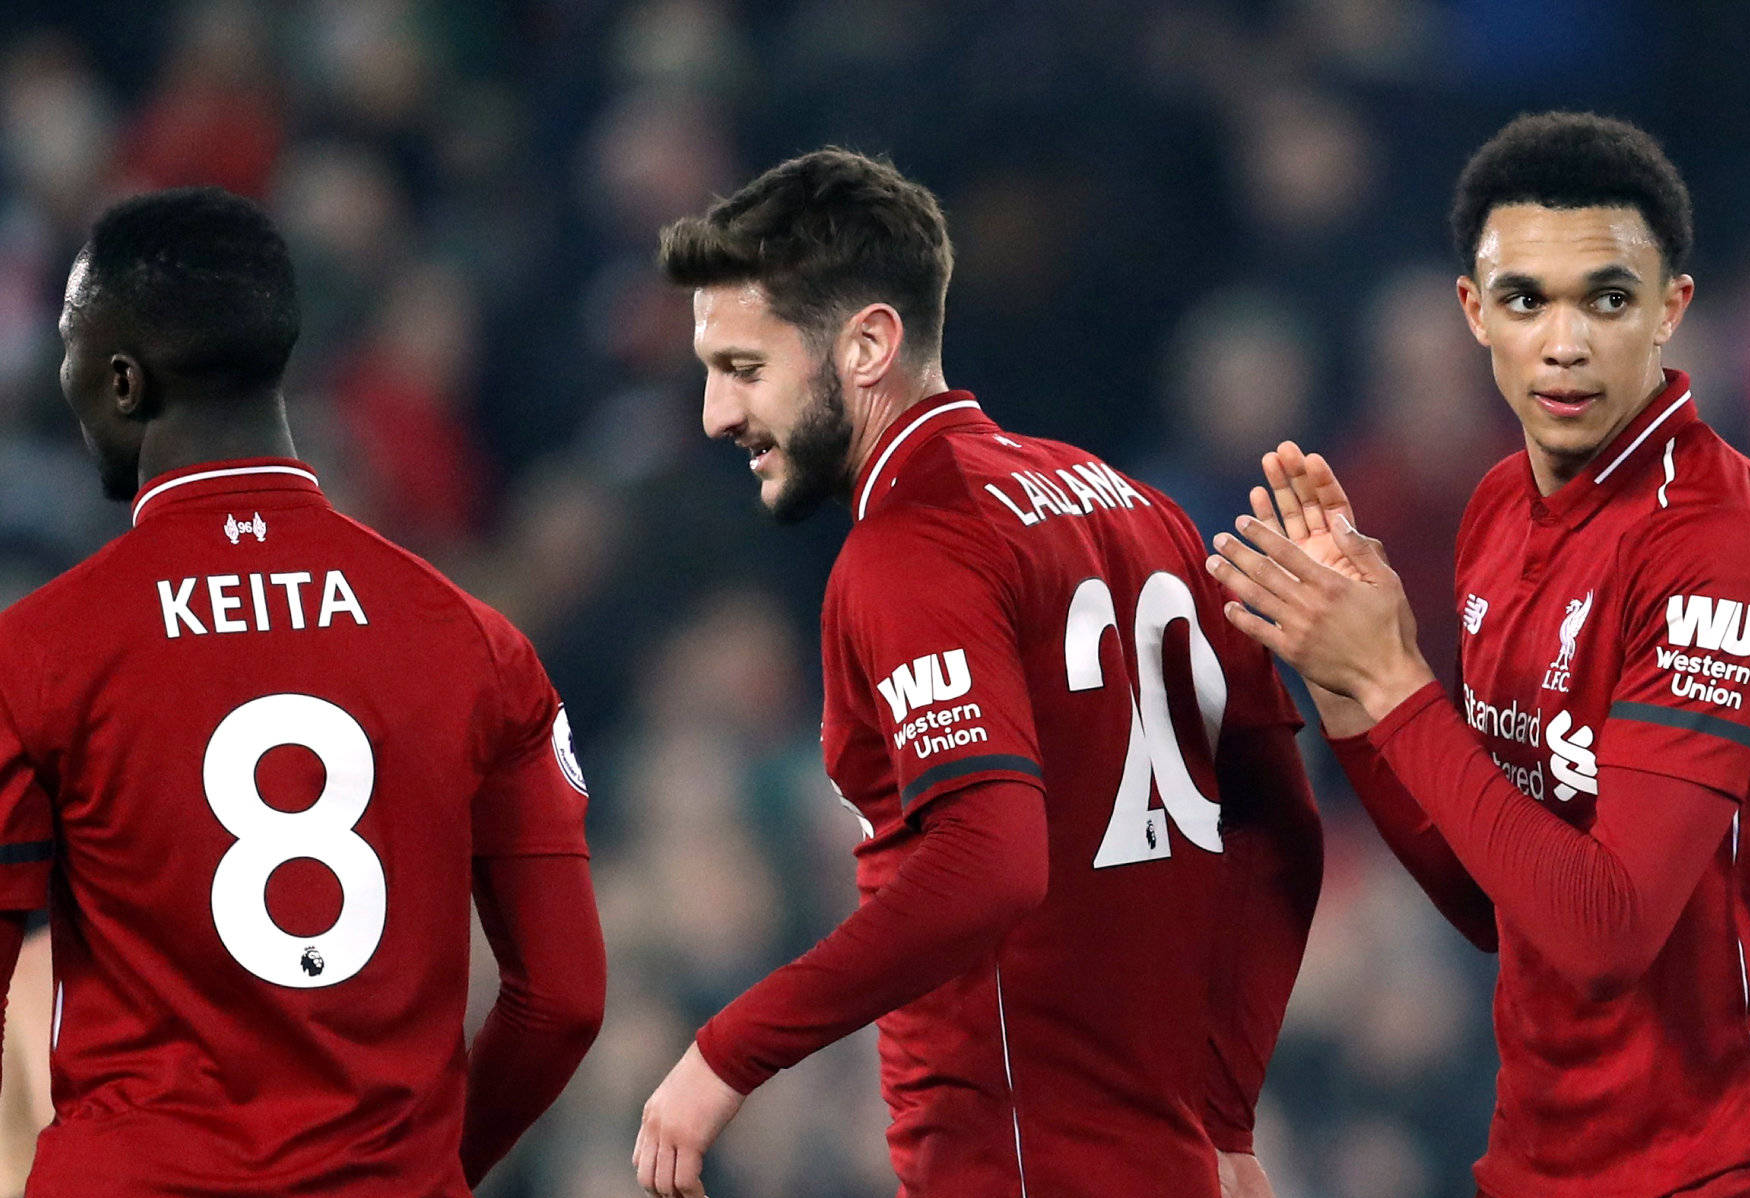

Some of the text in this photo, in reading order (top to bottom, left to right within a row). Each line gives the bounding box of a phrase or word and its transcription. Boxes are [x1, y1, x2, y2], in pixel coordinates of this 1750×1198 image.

[237, 521, 253, 534] 96
[157, 569, 369, 638] KEITA
[877, 648, 972, 724] WU
[1656, 646, 1750, 685] Western
[1671, 673, 1742, 710] Union
[894, 703, 982, 750] Western
[914, 726, 988, 759] Union
[1064, 570, 1229, 869] 20
[203, 693, 387, 989] 8
